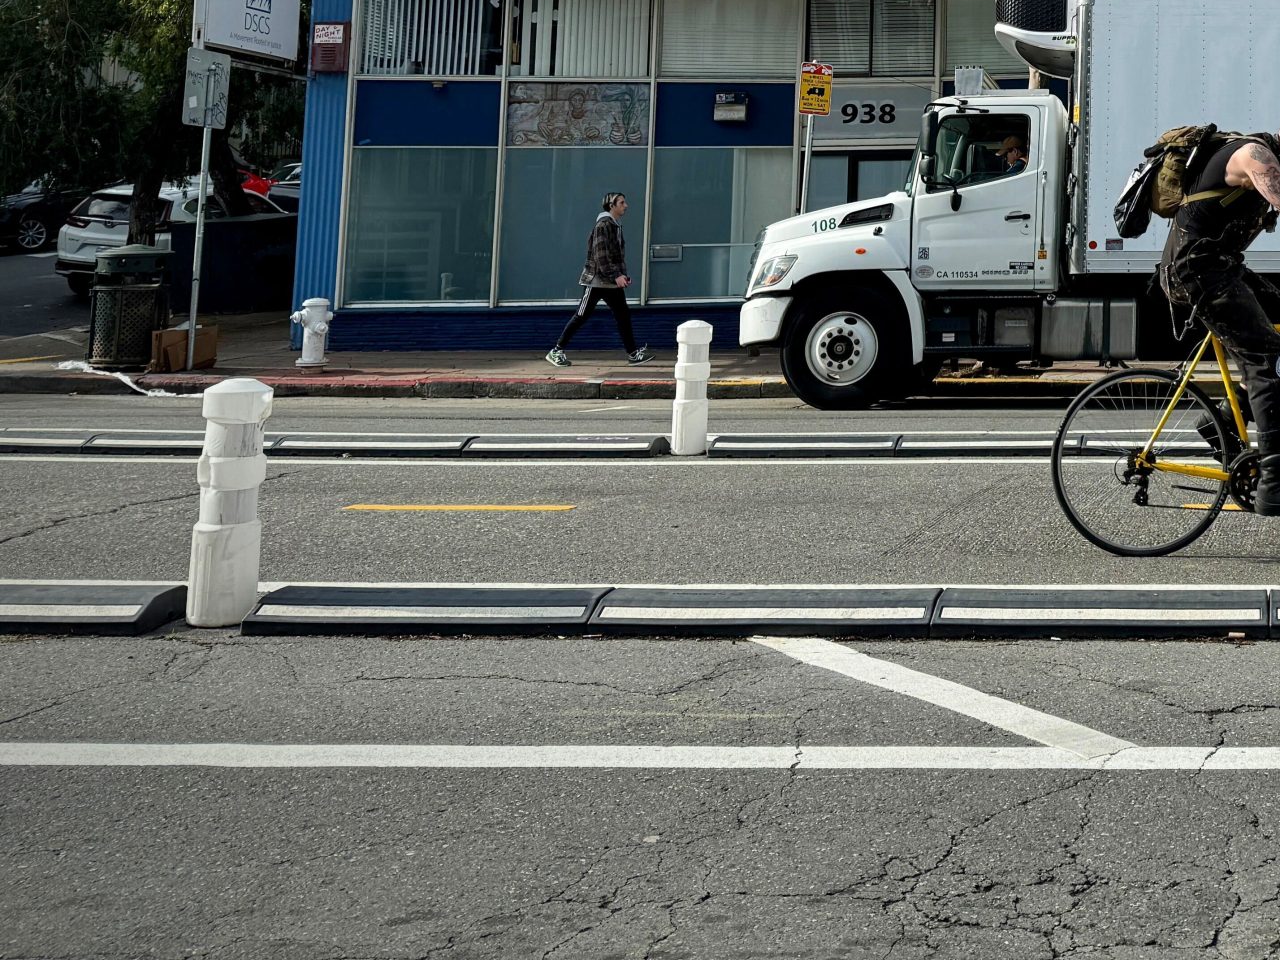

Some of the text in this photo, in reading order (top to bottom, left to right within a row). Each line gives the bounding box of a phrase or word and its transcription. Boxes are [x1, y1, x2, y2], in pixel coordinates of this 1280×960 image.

[245, 12, 271, 35] DSCS
[316, 30, 341, 39] NIGHT
[841, 103, 896, 124] 938
[811, 217, 837, 233] 108
[936, 271, 949, 279] CA
[951, 271, 979, 279] 110534
